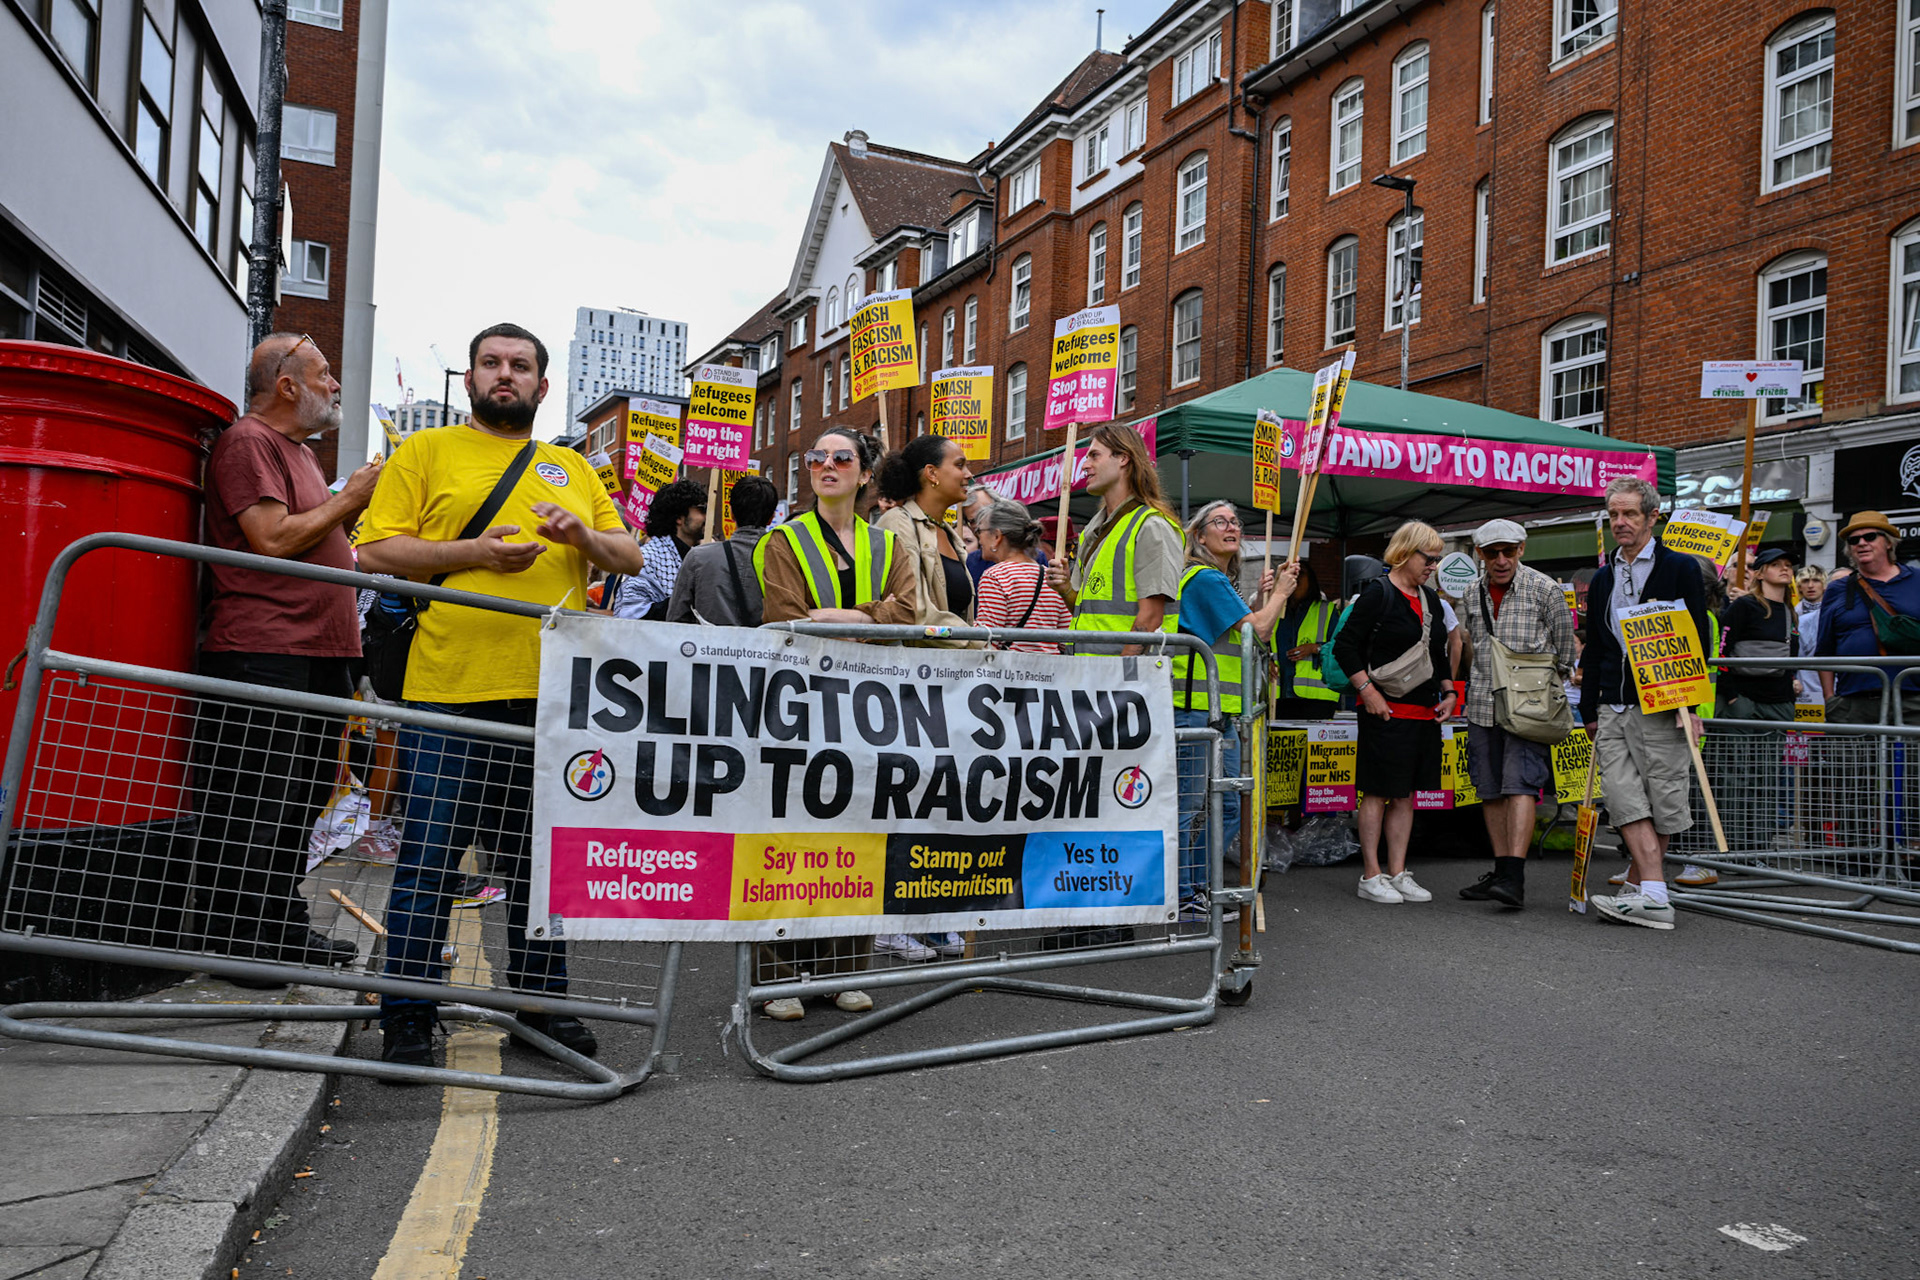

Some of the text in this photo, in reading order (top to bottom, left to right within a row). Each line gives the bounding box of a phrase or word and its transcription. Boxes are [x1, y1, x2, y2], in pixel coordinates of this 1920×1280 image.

[852, 305, 889, 334] SMASH
[1076, 311, 1092, 320] STAND
[1082, 318, 1105, 326] RACISM
[853, 324, 902, 355] FASCISM
[1056, 332, 1116, 355] Refugees
[854, 344, 913, 376] & RACISM
[1055, 351, 1111, 372] welcome
[714, 369, 732, 377] STAND
[722, 376, 742, 384] RACISM
[693, 384, 752, 404] Refugees
[934, 380, 972, 398] SMASH
[1052, 374, 1106, 398] Stop the
[691, 402, 747, 420] welcome
[933, 400, 981, 418] FASCISM
[1050, 392, 1104, 416] far right
[632, 413, 676, 431] Refugees
[933, 420, 988, 435] & RACISM
[688, 422, 742, 442] Stop the
[686, 439, 740, 460] far right
[642, 450, 674, 478] Refugees
[1406, 442, 1442, 474] UP
[1449, 445, 1486, 478] TO
[1492, 450, 1593, 488] RACISM
[1021, 470, 1040, 498] UP
[1043, 464, 1058, 493] TO
[1255, 466, 1260, 482] &
[632, 484, 645, 504] Stop
[1704, 487, 1791, 506] Cuiine
[634, 505, 648, 523] rig
[724, 505, 729, 518] &
[1666, 524, 1722, 541] Refugees
[1662, 538, 1713, 554] welcome
[1628, 606, 1658, 617] Socialist
[1624, 615, 1674, 640] SMASH
[1630, 636, 1691, 662] FASCISM
[701, 646, 810, 666] standuptoracism.org.uk
[834, 660, 910, 678] @AntiRacismDay
[976, 668, 1001, 678] Stand
[1004, 670, 1014, 682] Up
[1016, 671, 1024, 680] To
[1638, 657, 1705, 685] & RACISM
[568, 656, 1151, 750] ISLINGTON STAND
[1656, 690, 1664, 698] By
[1658, 696, 1689, 706] necessary
[1267, 735, 1295, 748] ARCH
[1557, 733, 1588, 748] ARCH
[1267, 748, 1304, 760] GAINST
[1310, 744, 1355, 759] Migrants
[1558, 744, 1592, 760] AGAINS
[1267, 760, 1298, 773] SCISM
[1310, 759, 1337, 770] make
[1555, 756, 1591, 772] FASCIS
[634, 741, 1103, 823] UP TO RACISM
[1310, 770, 1350, 782] our NHS
[1308, 788, 1322, 796] Stop
[1308, 795, 1348, 804] scapegoating
[1416, 791, 1445, 800] Refugees
[586, 840, 698, 874] Refugees
[764, 846, 855, 874] Say no to
[909, 844, 1006, 874] Stamp out
[1063, 842, 1119, 864] Yes to
[587, 874, 693, 902] welcome
[743, 875, 873, 905] Islamophobia
[894, 874, 1014, 899] antisemitism
[1054, 870, 1133, 895] diversity
